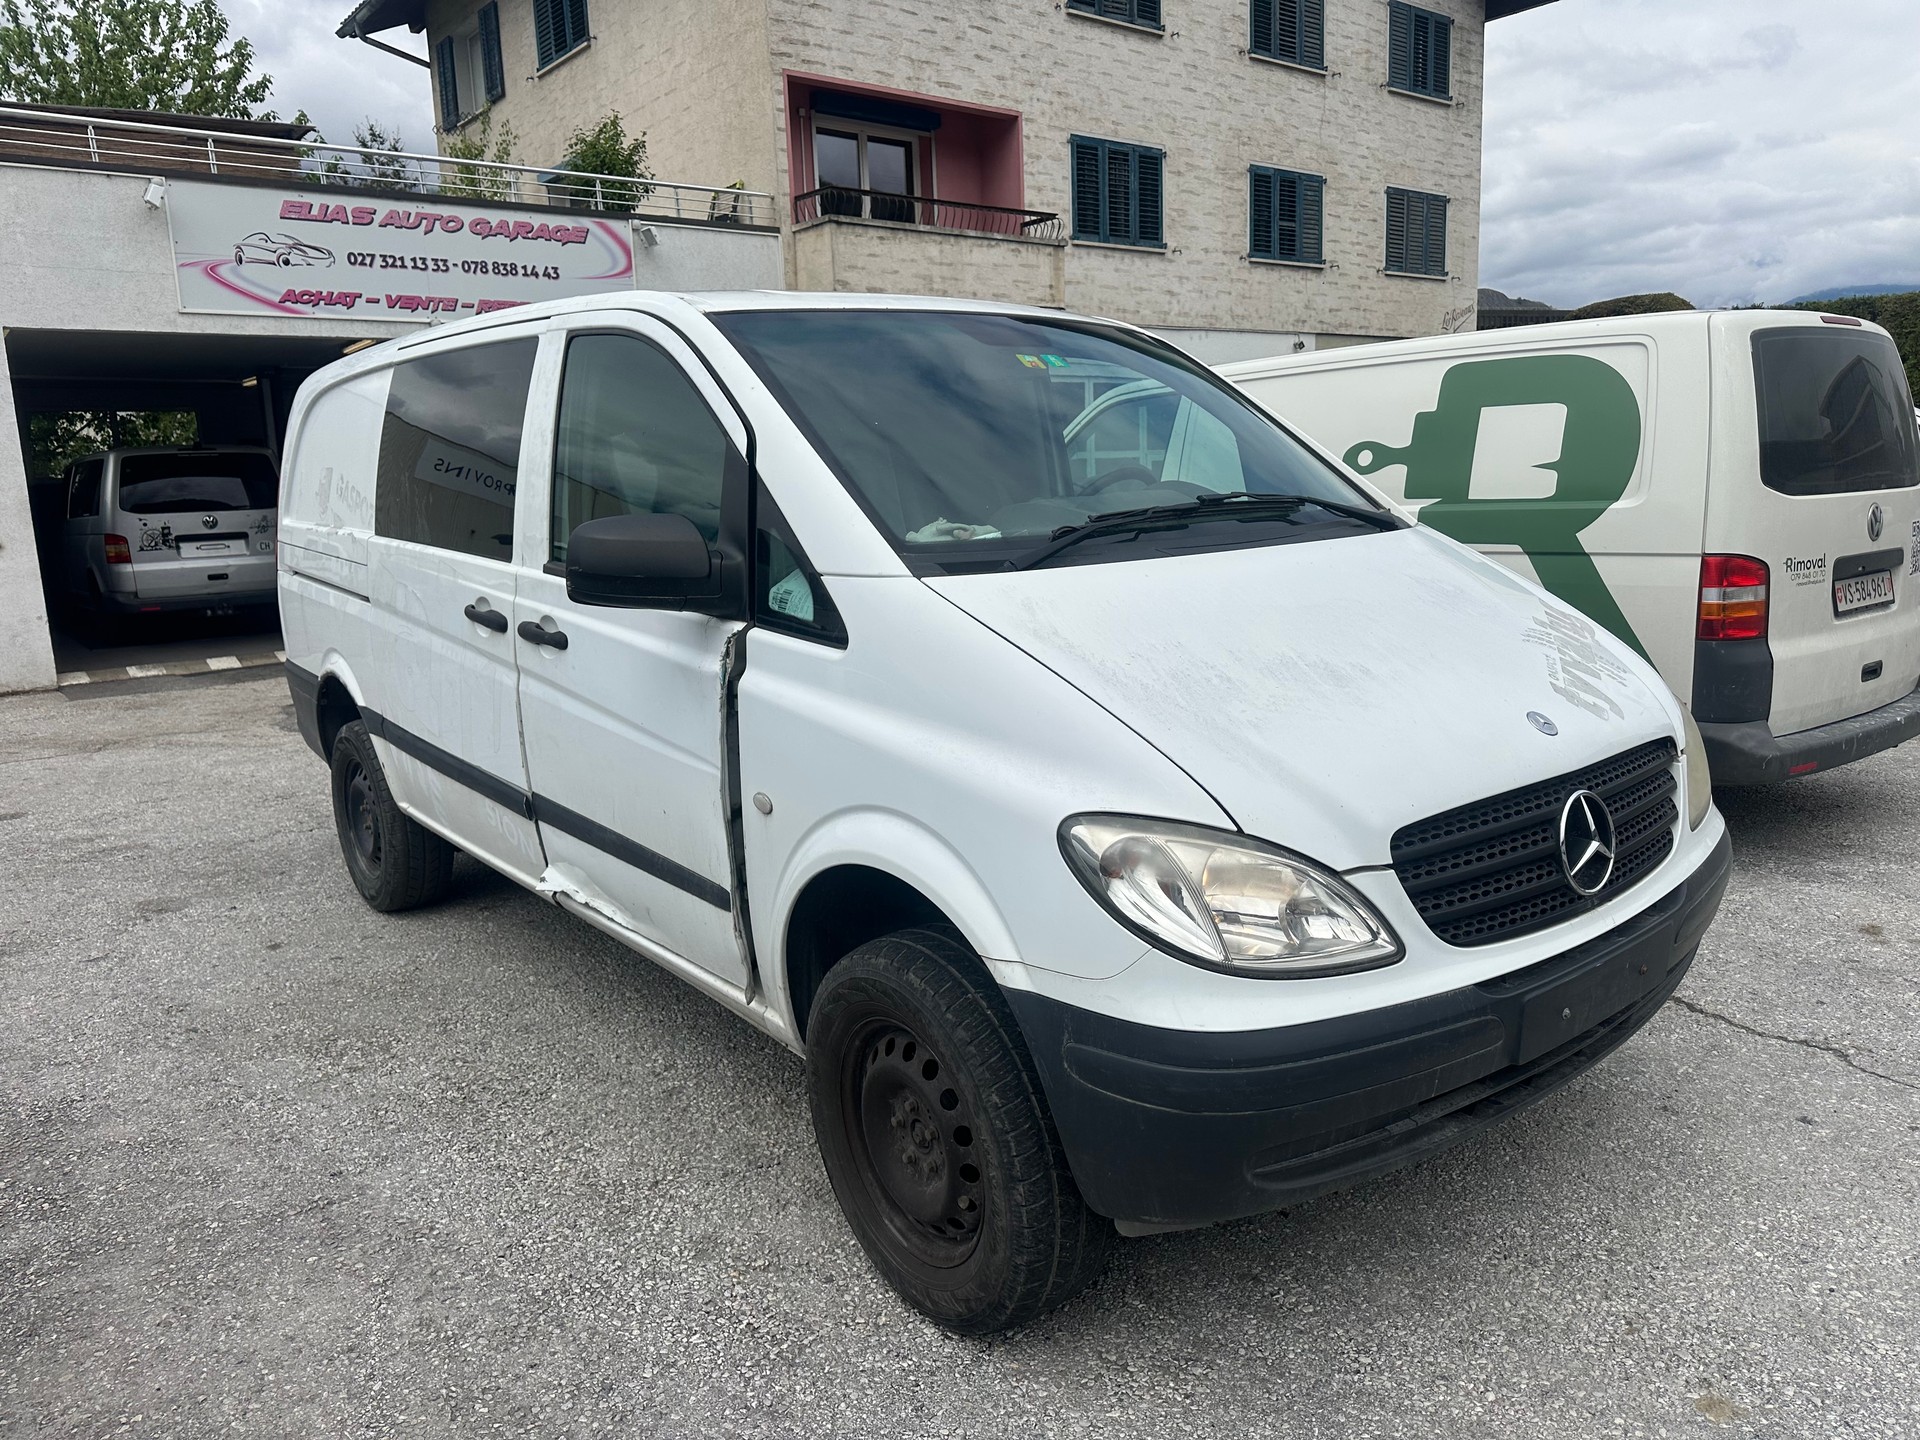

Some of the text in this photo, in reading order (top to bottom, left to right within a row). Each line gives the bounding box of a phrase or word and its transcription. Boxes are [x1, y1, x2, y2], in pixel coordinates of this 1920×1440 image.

[280, 200, 589, 246] ELIAS AUTO GARAGE
[347, 252, 375, 268] 027
[379, 254, 408, 269] 321
[410, 256, 429, 271] 13
[431, 258, 449, 272] 33
[461, 260, 489, 275] 078
[491, 261, 518, 276] 838
[521, 265, 539, 279] 14
[542, 266, 560, 280] 43
[279, 289, 362, 309] ACHAT
[385, 294, 458, 314] VENTE
[260, 542, 270, 550] CH
[1785, 553, 1826, 573] Rimoval
[1791, 573, 1801, 581] 079
